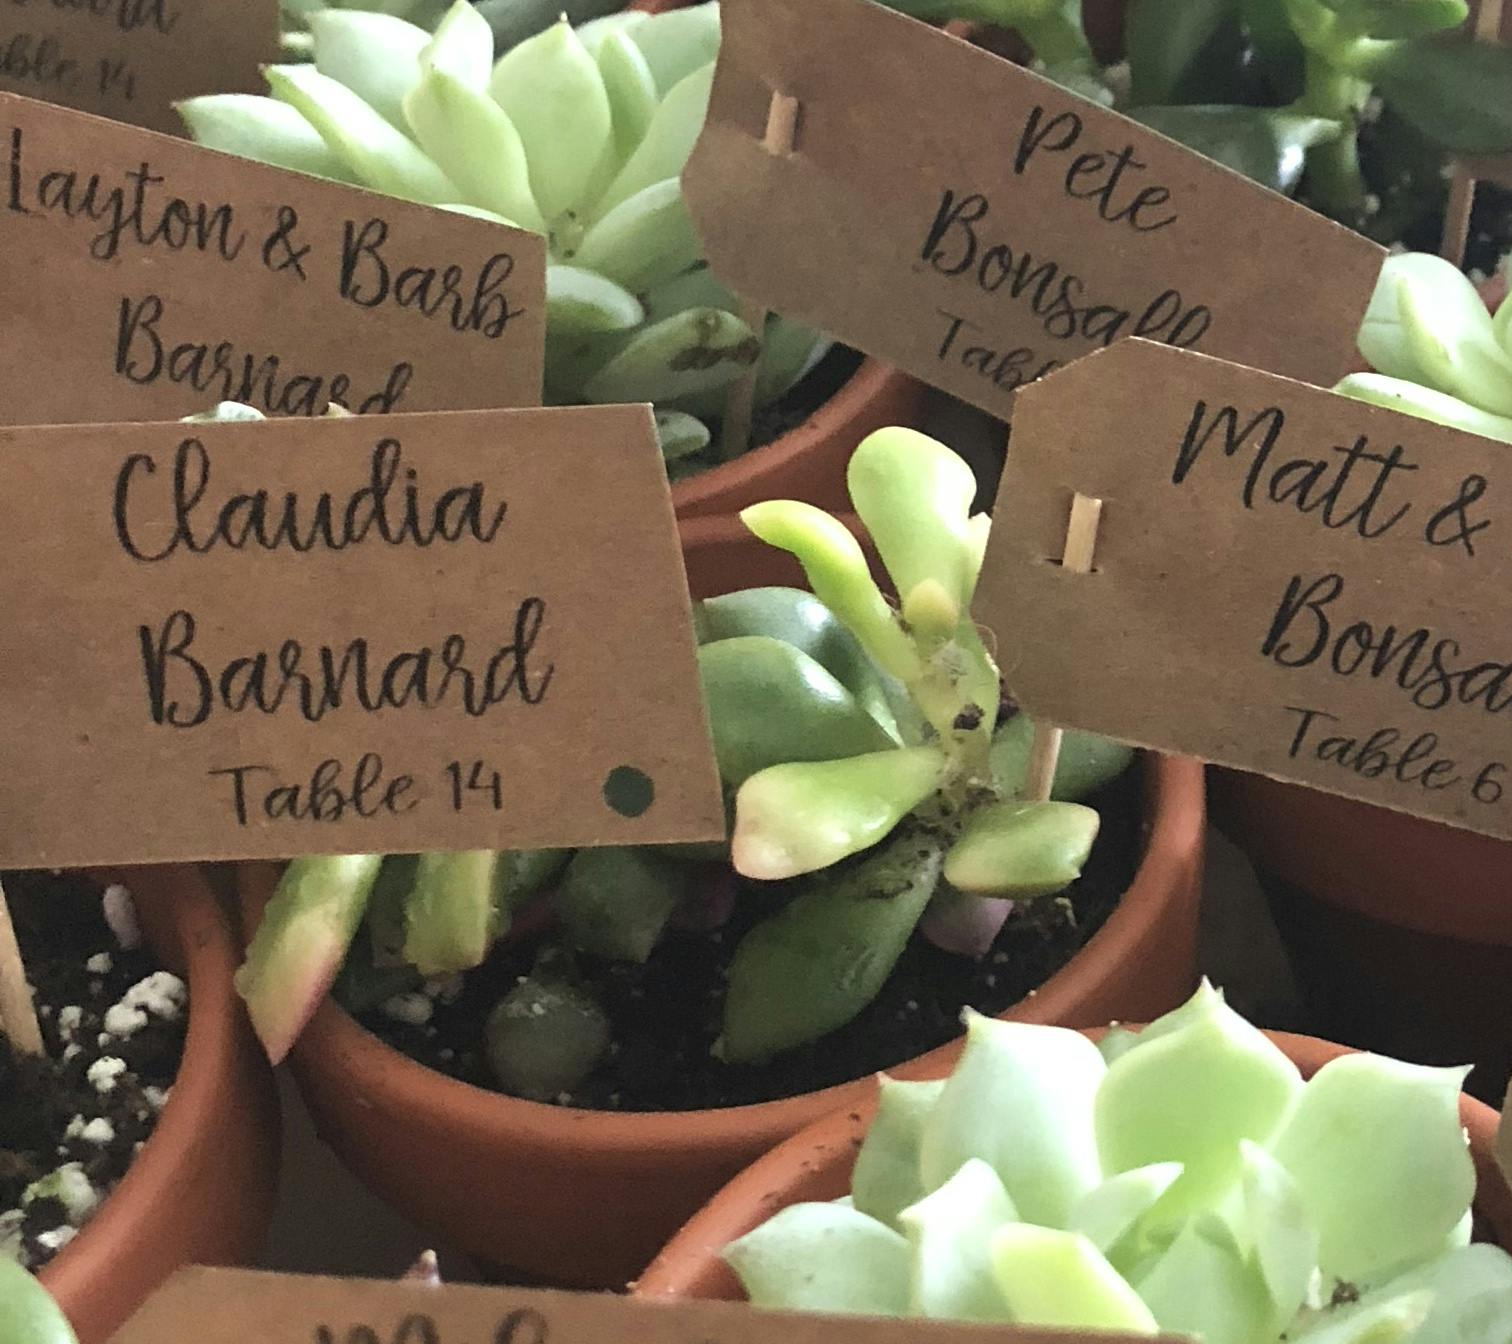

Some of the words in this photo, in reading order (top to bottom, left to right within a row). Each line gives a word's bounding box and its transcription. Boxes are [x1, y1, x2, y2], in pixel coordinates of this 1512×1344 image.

[1013, 104, 1177, 233] Pete
[2, 127, 246, 262] Layton
[262, 205, 312, 281] &
[338, 216, 525, 338] Barb
[921, 189, 1212, 348] Bonsall
[115, 294, 414, 416] Barnard
[936, 308, 1060, 391] Tab
[112, 437, 508, 563] Claudia
[1172, 398, 1421, 540] Matt
[1425, 473, 1493, 558] &
[138, 596, 556, 729] Barnard
[209, 752, 419, 825] Table
[445, 759, 506, 812] 14
[1283, 704, 1463, 792] Table
[1470, 762, 1507, 806] 6
